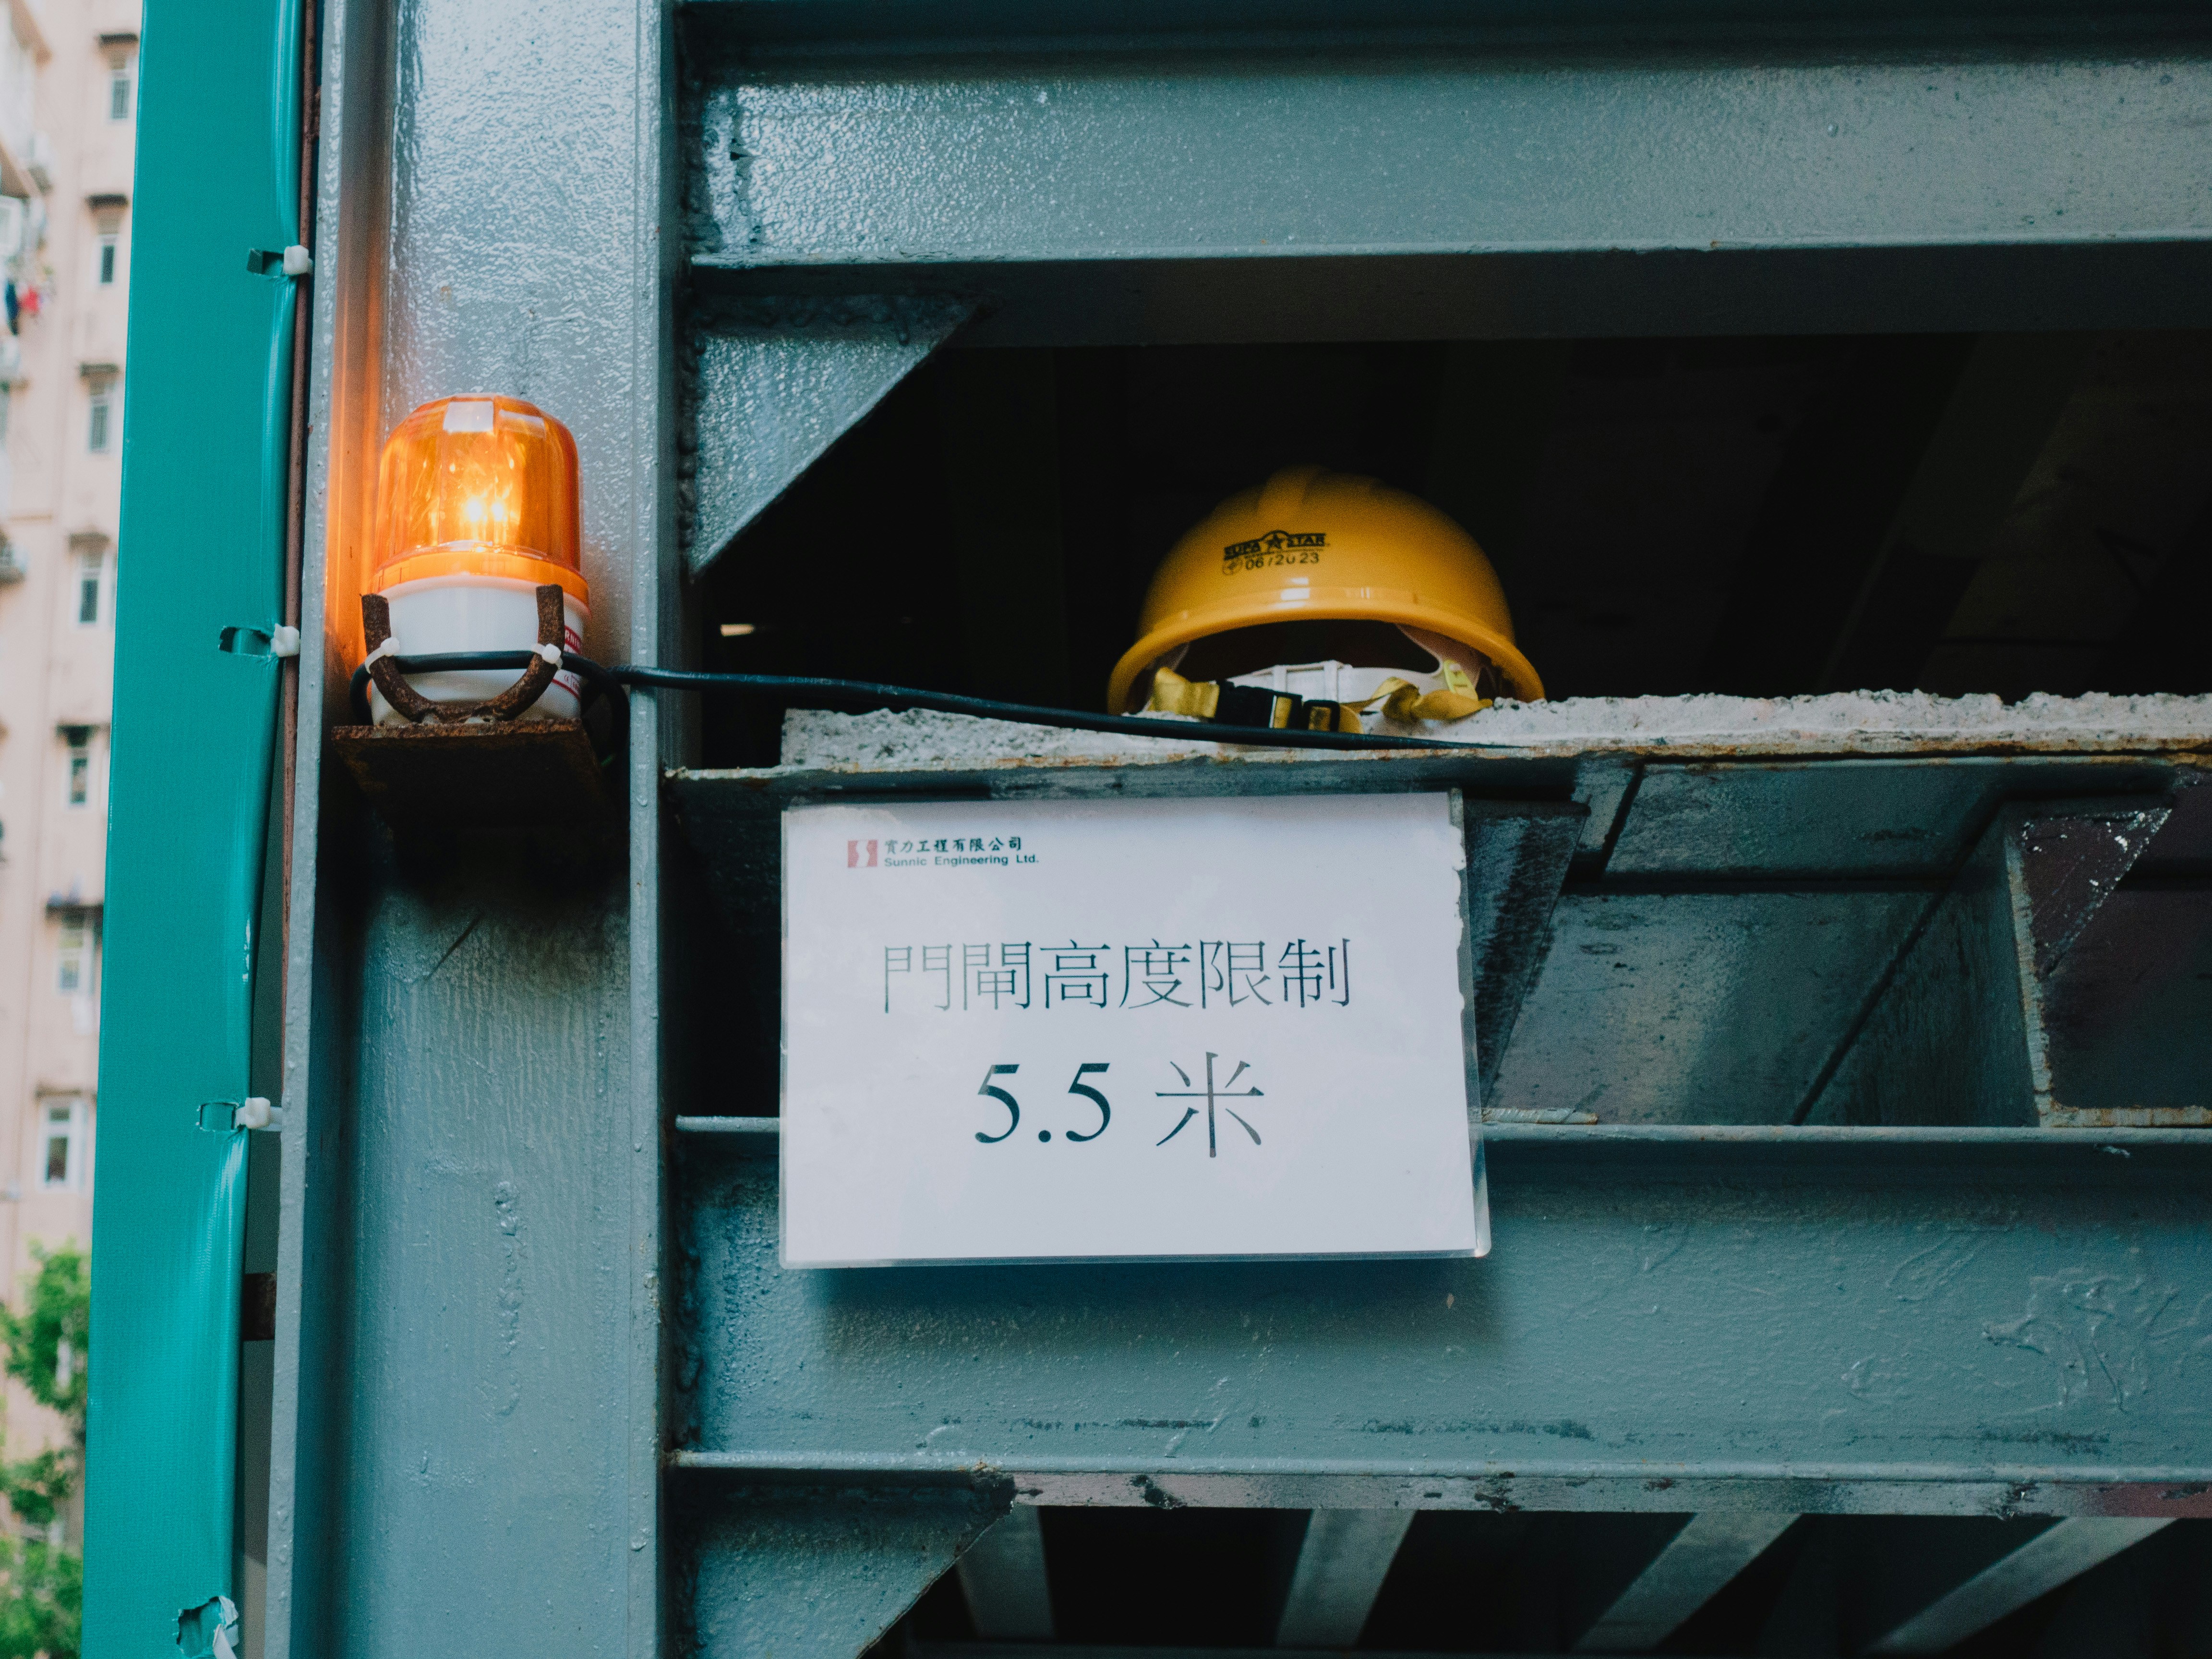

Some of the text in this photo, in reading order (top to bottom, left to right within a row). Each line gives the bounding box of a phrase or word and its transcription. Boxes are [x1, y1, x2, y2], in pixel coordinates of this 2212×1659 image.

[1287, 533, 1326, 548] STAR
[885, 854, 1040, 867] Sunnic Engineering Ltd.
[883, 938, 1351, 1014] 門閘高度限制
[975, 1052, 1264, 1158] 5.5 米
